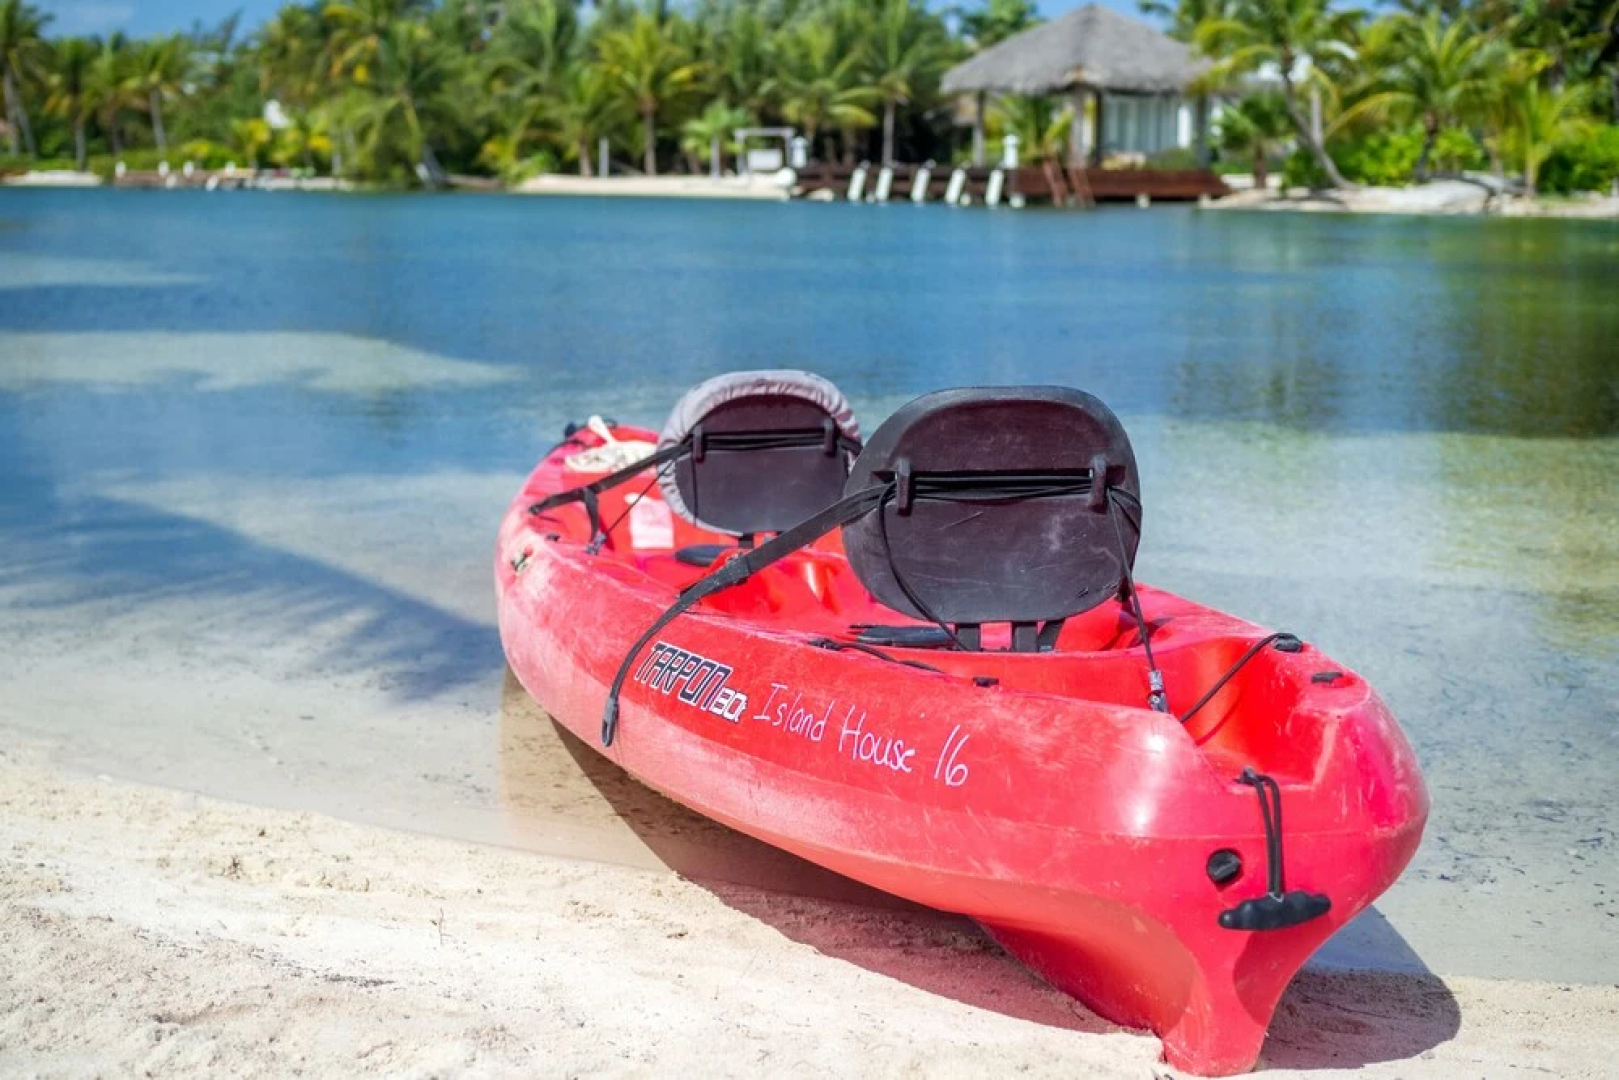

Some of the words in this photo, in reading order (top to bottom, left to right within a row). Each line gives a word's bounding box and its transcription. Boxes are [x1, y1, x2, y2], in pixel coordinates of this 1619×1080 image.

[634, 641, 734, 711] TARPON
[753, 682, 834, 742] Island
[838, 705, 916, 773] House
[933, 724, 970, 787] 16
